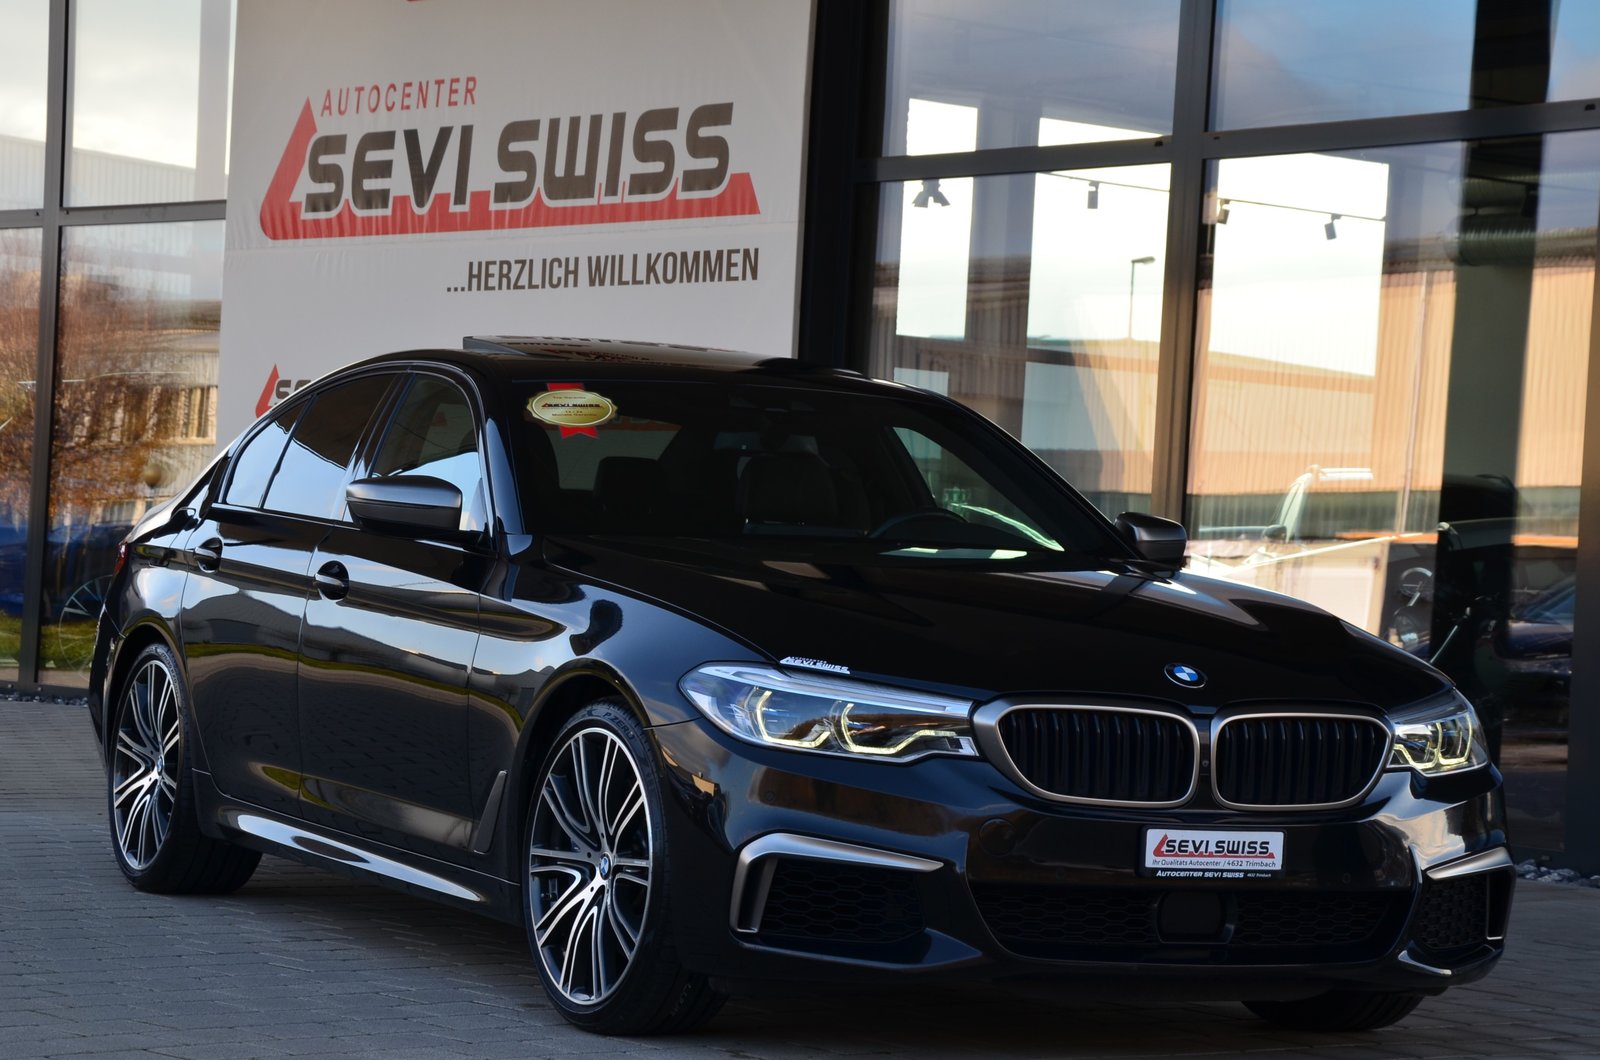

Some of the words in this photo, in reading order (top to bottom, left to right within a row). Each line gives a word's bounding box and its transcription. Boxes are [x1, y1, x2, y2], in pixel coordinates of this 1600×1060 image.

[320, 75, 478, 117] AUTOCENTER
[304, 124, 474, 214] SEVI
[492, 101, 735, 204] SWISS
[587, 247, 760, 288] WILLKOMMEN
[1165, 839, 1210, 854] SEVI
[1214, 840, 1270, 855] SWISS
[1188, 859, 1221, 867] Autocenter
[1245, 860, 1276, 868] Trimbach
